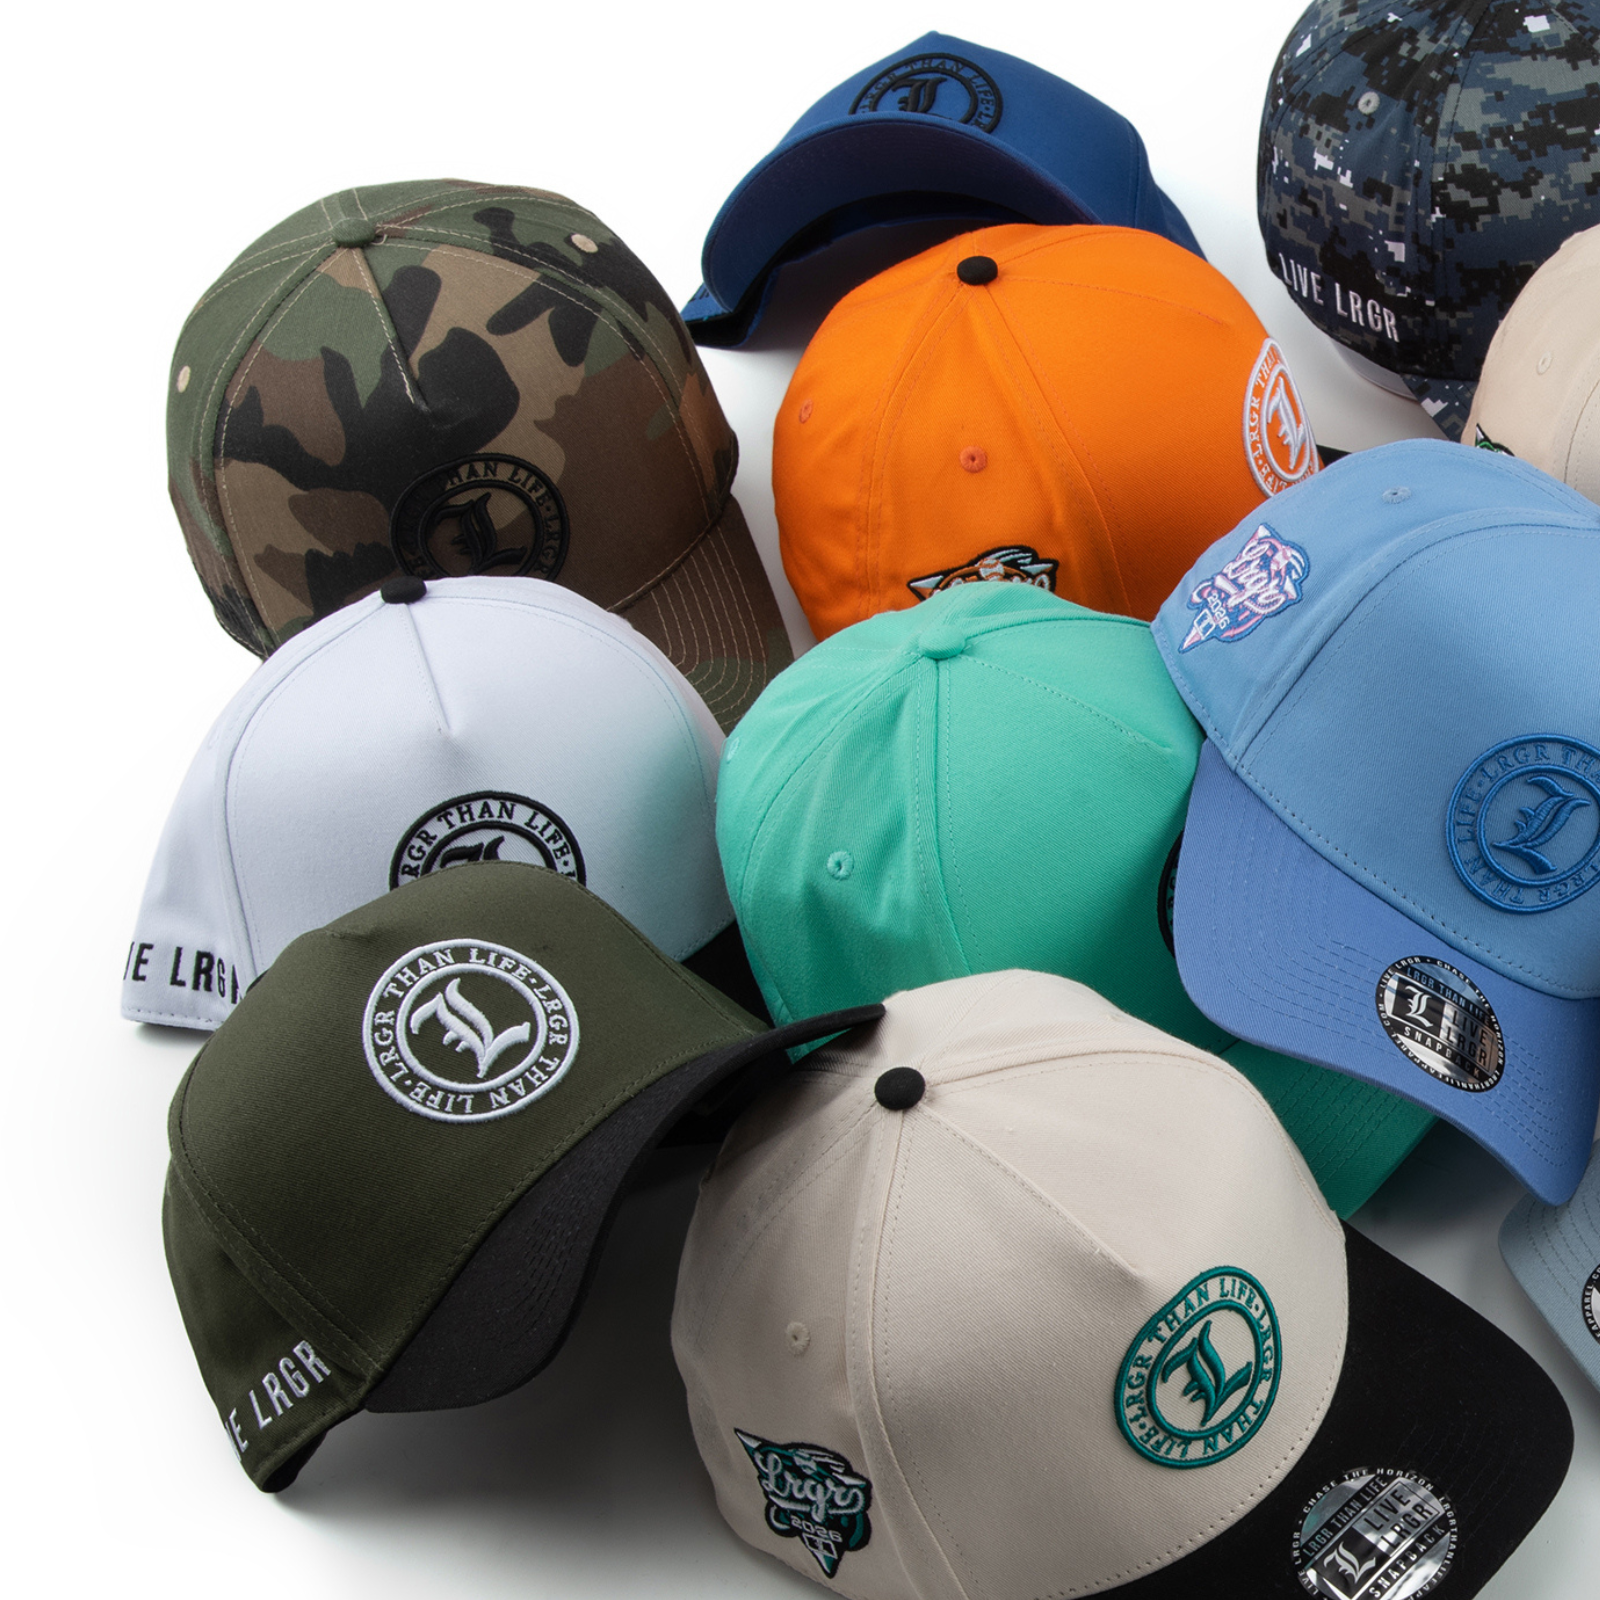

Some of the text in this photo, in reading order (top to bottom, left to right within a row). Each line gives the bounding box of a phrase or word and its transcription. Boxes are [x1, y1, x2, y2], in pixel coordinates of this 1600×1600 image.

[905, 58, 965, 72] THAN
[968, 74, 994, 106] LIFE
[1279, 252, 1400, 343] LIVE LRGR
[1249, 397, 1263, 461] LRGR
[508, 464, 552, 506] LIFE
[1481, 744, 1550, 782] LRGR
[1456, 787, 1482, 844] LIFE
[1492, 776, 1592, 875] L
[401, 830, 437, 878] RGR
[437, 800, 516, 829] THAN
[524, 811, 571, 860] LIFE
[1464, 855, 1525, 904] THAN
[1538, 861, 1599, 901] LRGR
[1395, 956, 1421, 969] LRGR
[1436, 960, 1471, 985] CHASE
[1475, 989, 1490, 1008] THE
[1406, 967, 1435, 989] LRGR
[1439, 983, 1466, 1008] THAN
[410, 977, 531, 1079] L
[1405, 985, 1434, 1028] L
[1452, 1010, 1489, 1048] LIVE
[374, 948, 568, 1113] LRGR THAN LIFE LRGR THAN LIFE
[1404, 1026, 1480, 1078] SNAPBACK
[1446, 1026, 1488, 1067] LRGR
[1148, 1282, 1210, 1344] THAN
[1219, 1277, 1256, 1308] LIFE
[249, 1339, 331, 1430] LRGR
[1126, 1354, 1153, 1424] LRGR
[1162, 1320, 1253, 1426] L
[1139, 1425, 1192, 1458] LIFE
[1202, 1399, 1265, 1455] THAN
[1303, 1480, 1338, 1514] CHASE
[1343, 1469, 1369, 1481] THE
[1376, 1467, 1434, 1491] HORIZON
[791, 1514, 843, 1543] 2026
[1302, 1476, 1388, 1558] LRGR THAN LIFE
[1363, 1489, 1411, 1531] LIVE
[1381, 1504, 1434, 1548] LRGR
[1292, 1531, 1302, 1565] LRGR
[1323, 1541, 1377, 1584] L
[1368, 1524, 1446, 1598] SNAPBACK
[1298, 1569, 1319, 1596] LIVE
